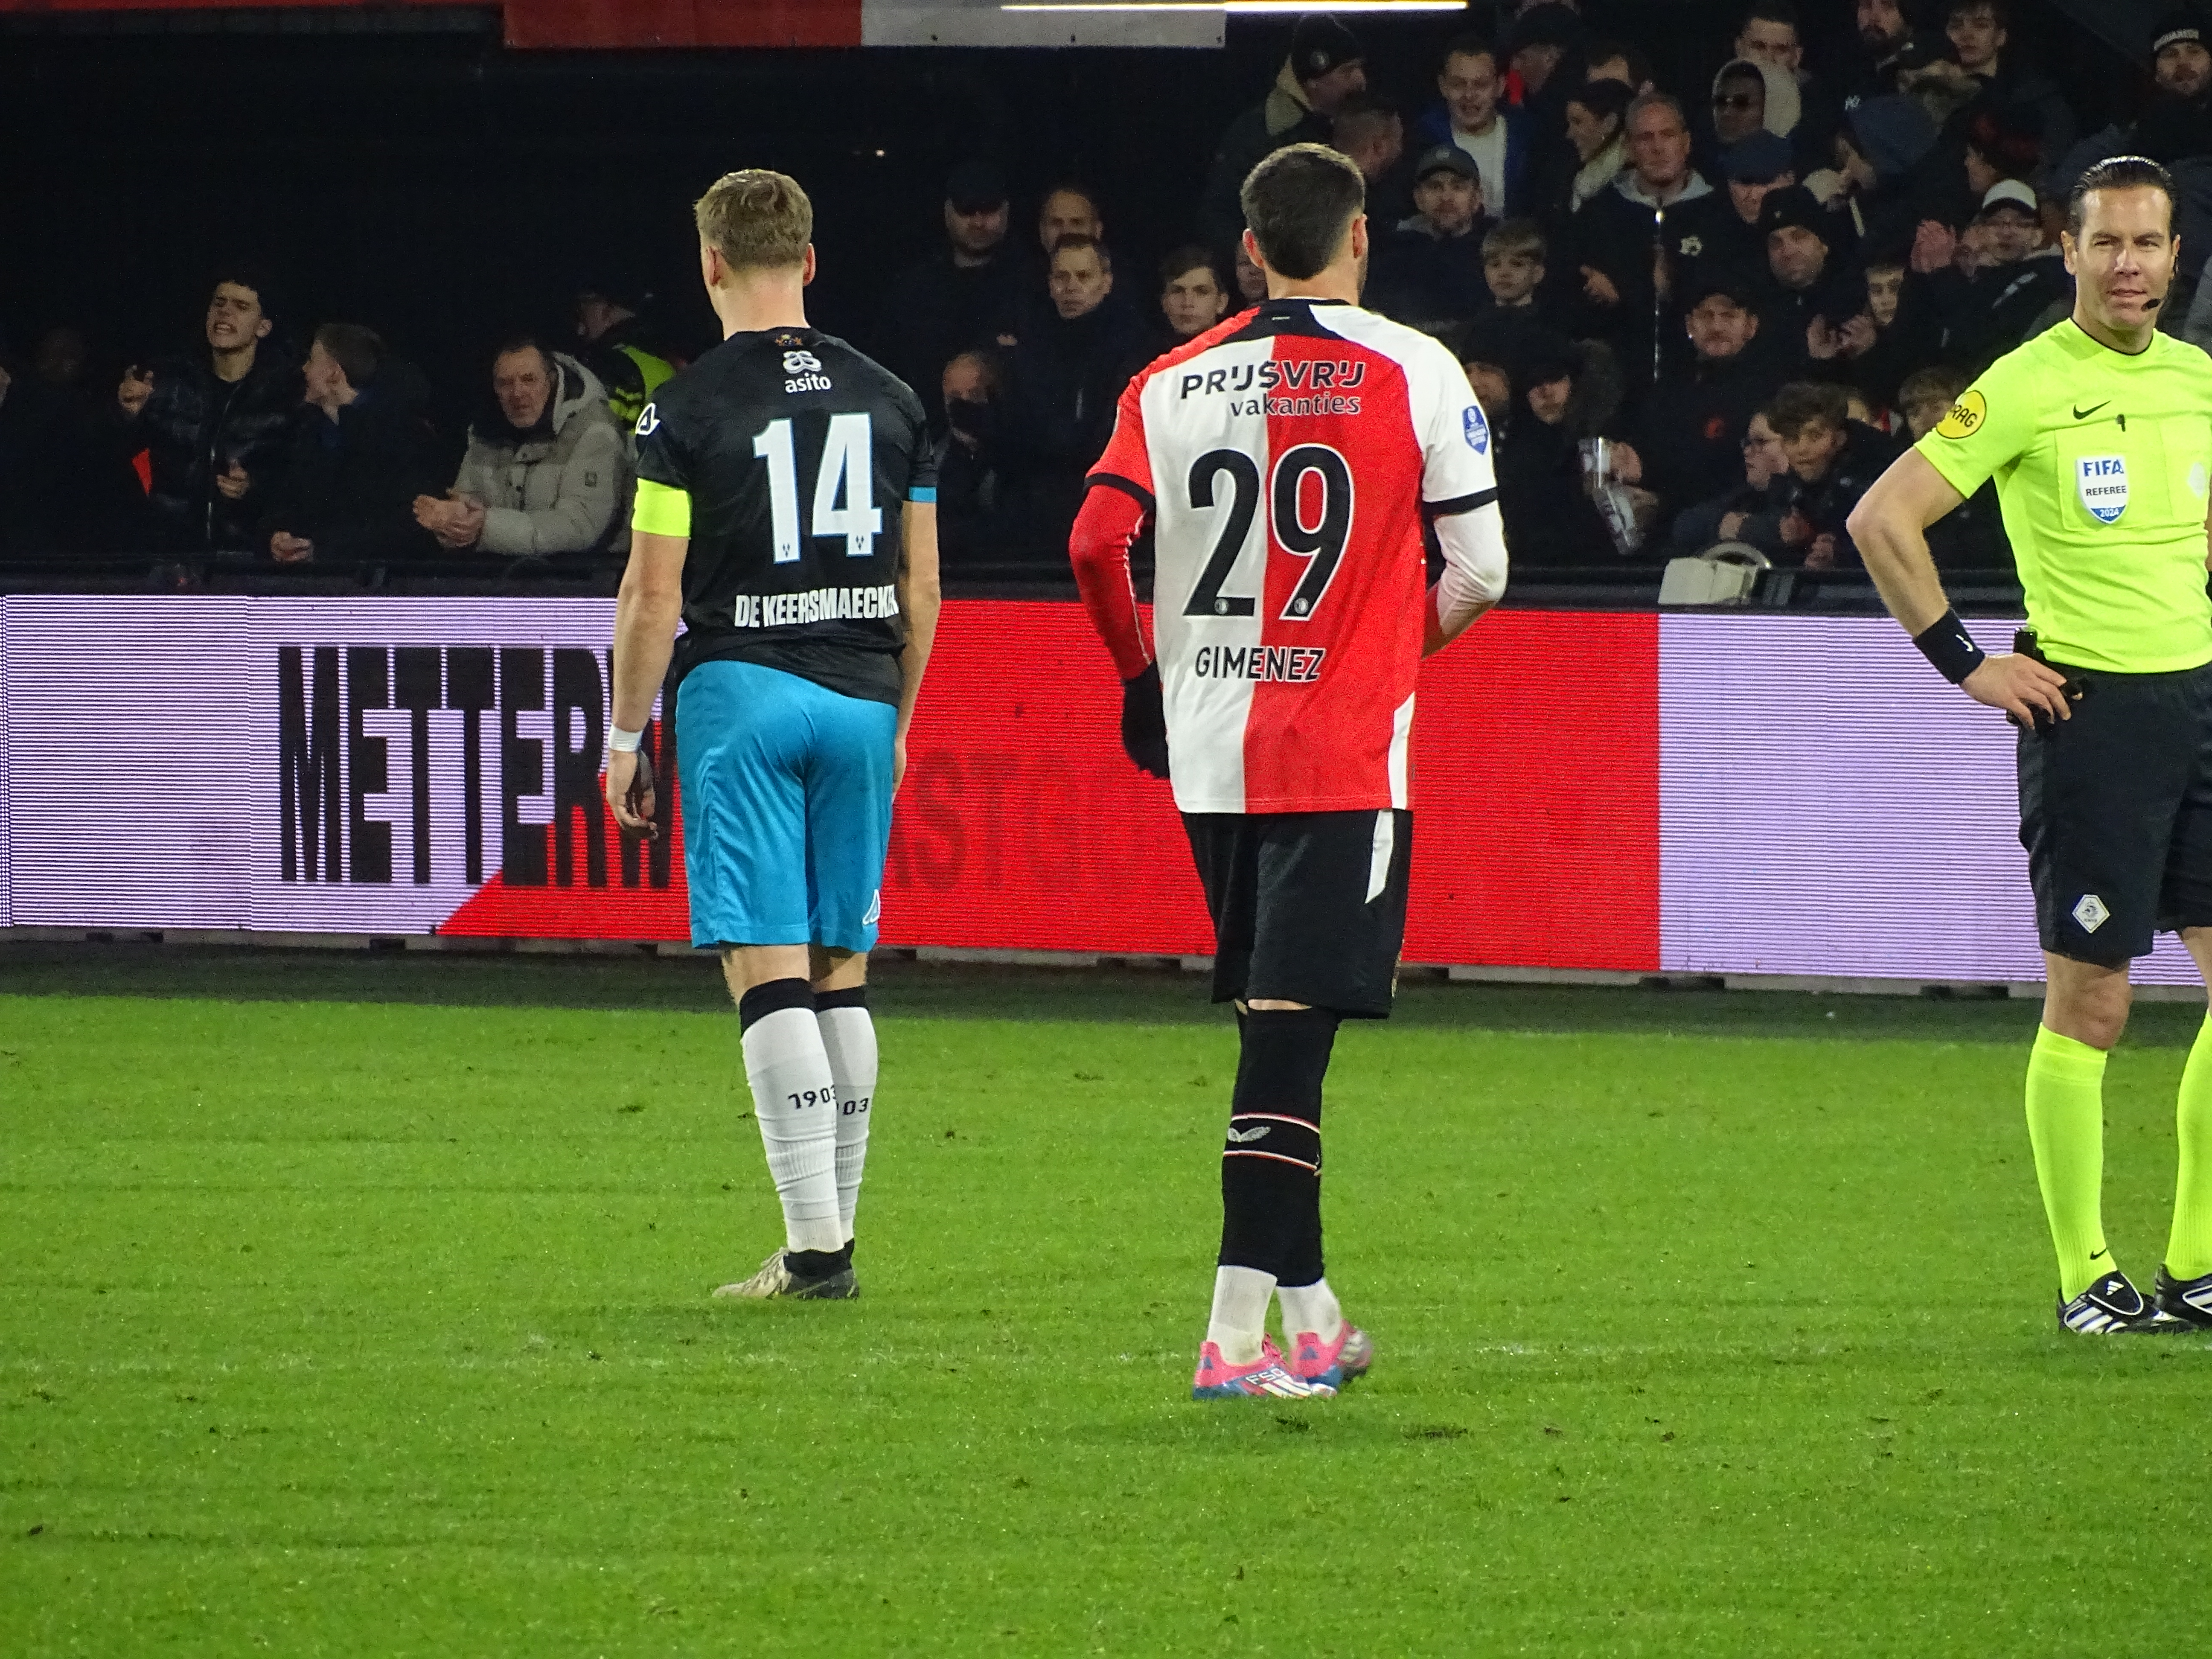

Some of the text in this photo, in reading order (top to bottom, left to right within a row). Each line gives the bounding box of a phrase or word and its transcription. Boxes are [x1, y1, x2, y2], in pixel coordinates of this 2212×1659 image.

[785, 372, 831, 393] asito
[1230, 392, 1360, 416] vakanties
[2083, 459, 2124, 477] FIFA
[752, 412, 882, 564] 14
[2086, 486, 2127, 496] REFEREE
[2099, 508, 2119, 517] 2024
[1182, 443, 1355, 621] 29
[735, 595, 760, 628] DE
[1195, 646, 1326, 681] GIMENEZ
